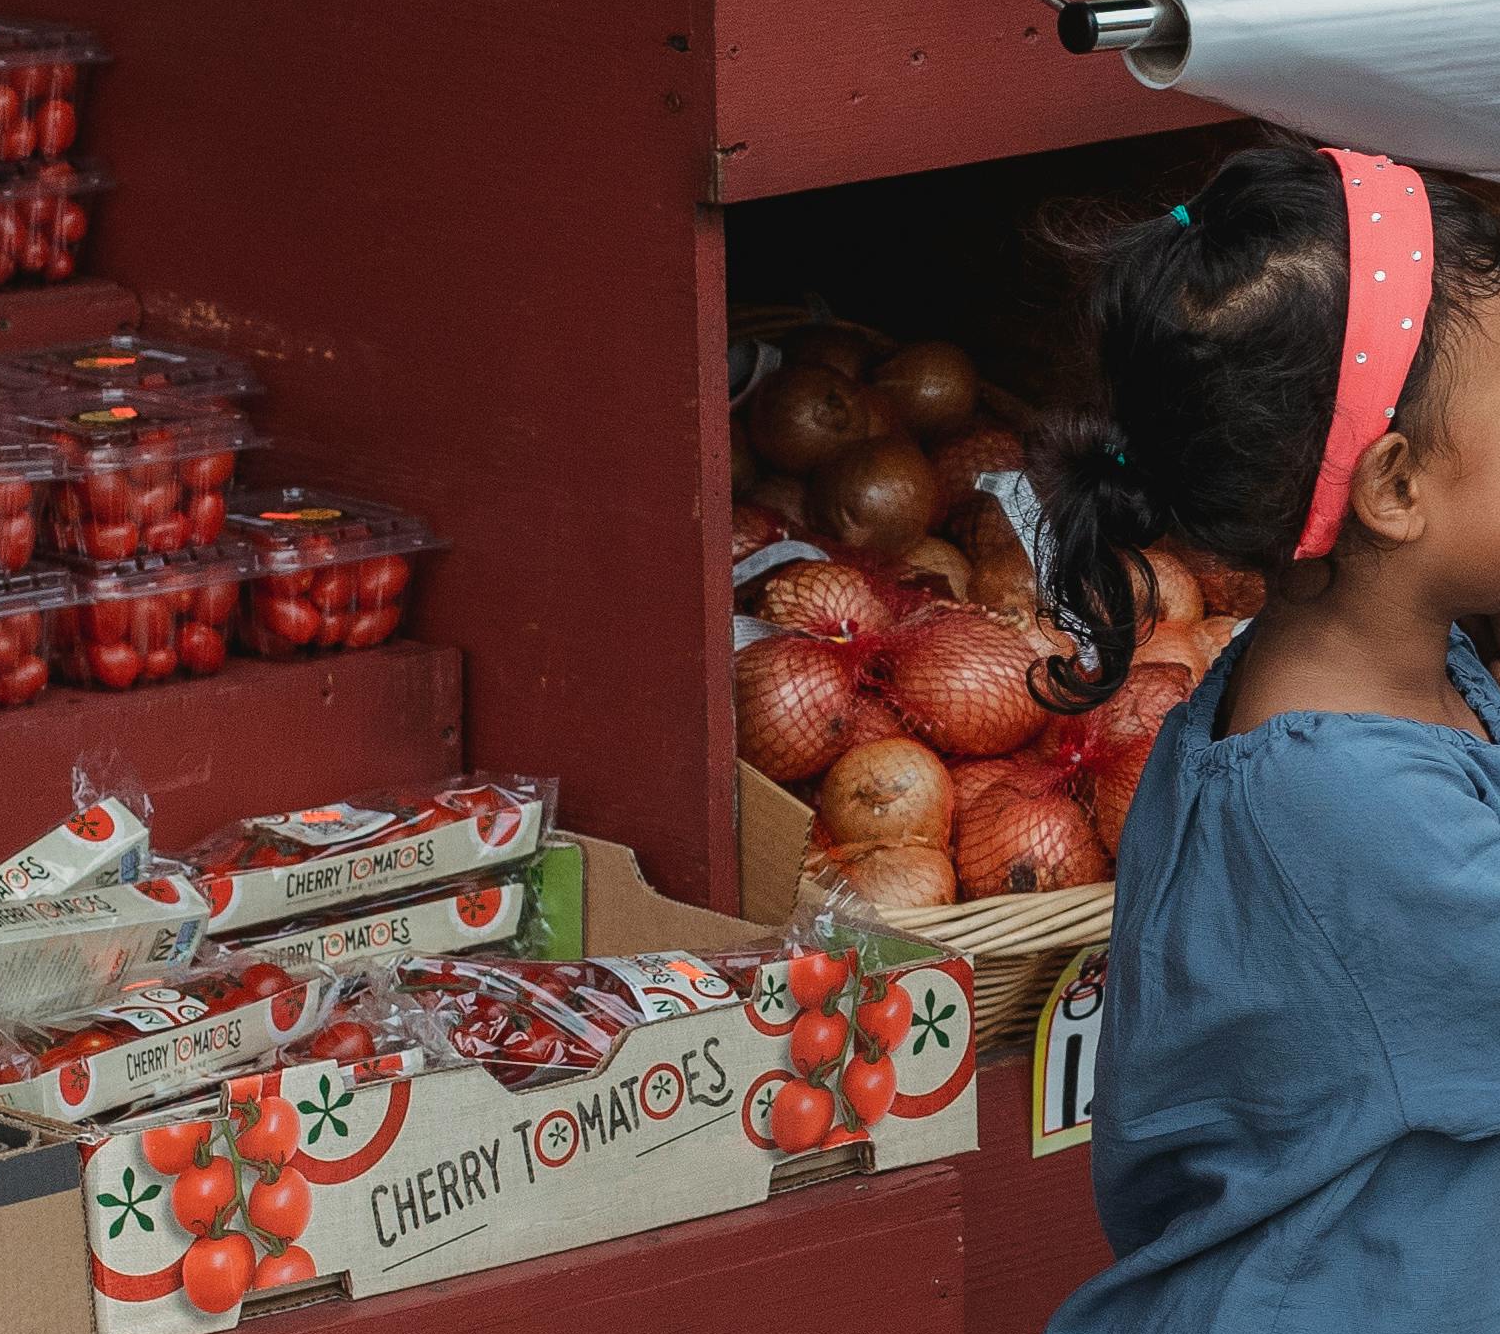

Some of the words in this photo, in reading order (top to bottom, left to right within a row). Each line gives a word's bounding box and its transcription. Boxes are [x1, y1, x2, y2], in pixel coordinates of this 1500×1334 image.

[285, 864, 342, 899] CHERRY
[347, 838, 435, 882] TOMATOES
[319, 916, 412, 958] TOMATOES
[126, 1044, 169, 1082] CHERRY
[173, 1018, 243, 1062] TOMATOES
[370, 1138, 502, 1248] CHERRY
[512, 1036, 735, 1184] TOMATOES
